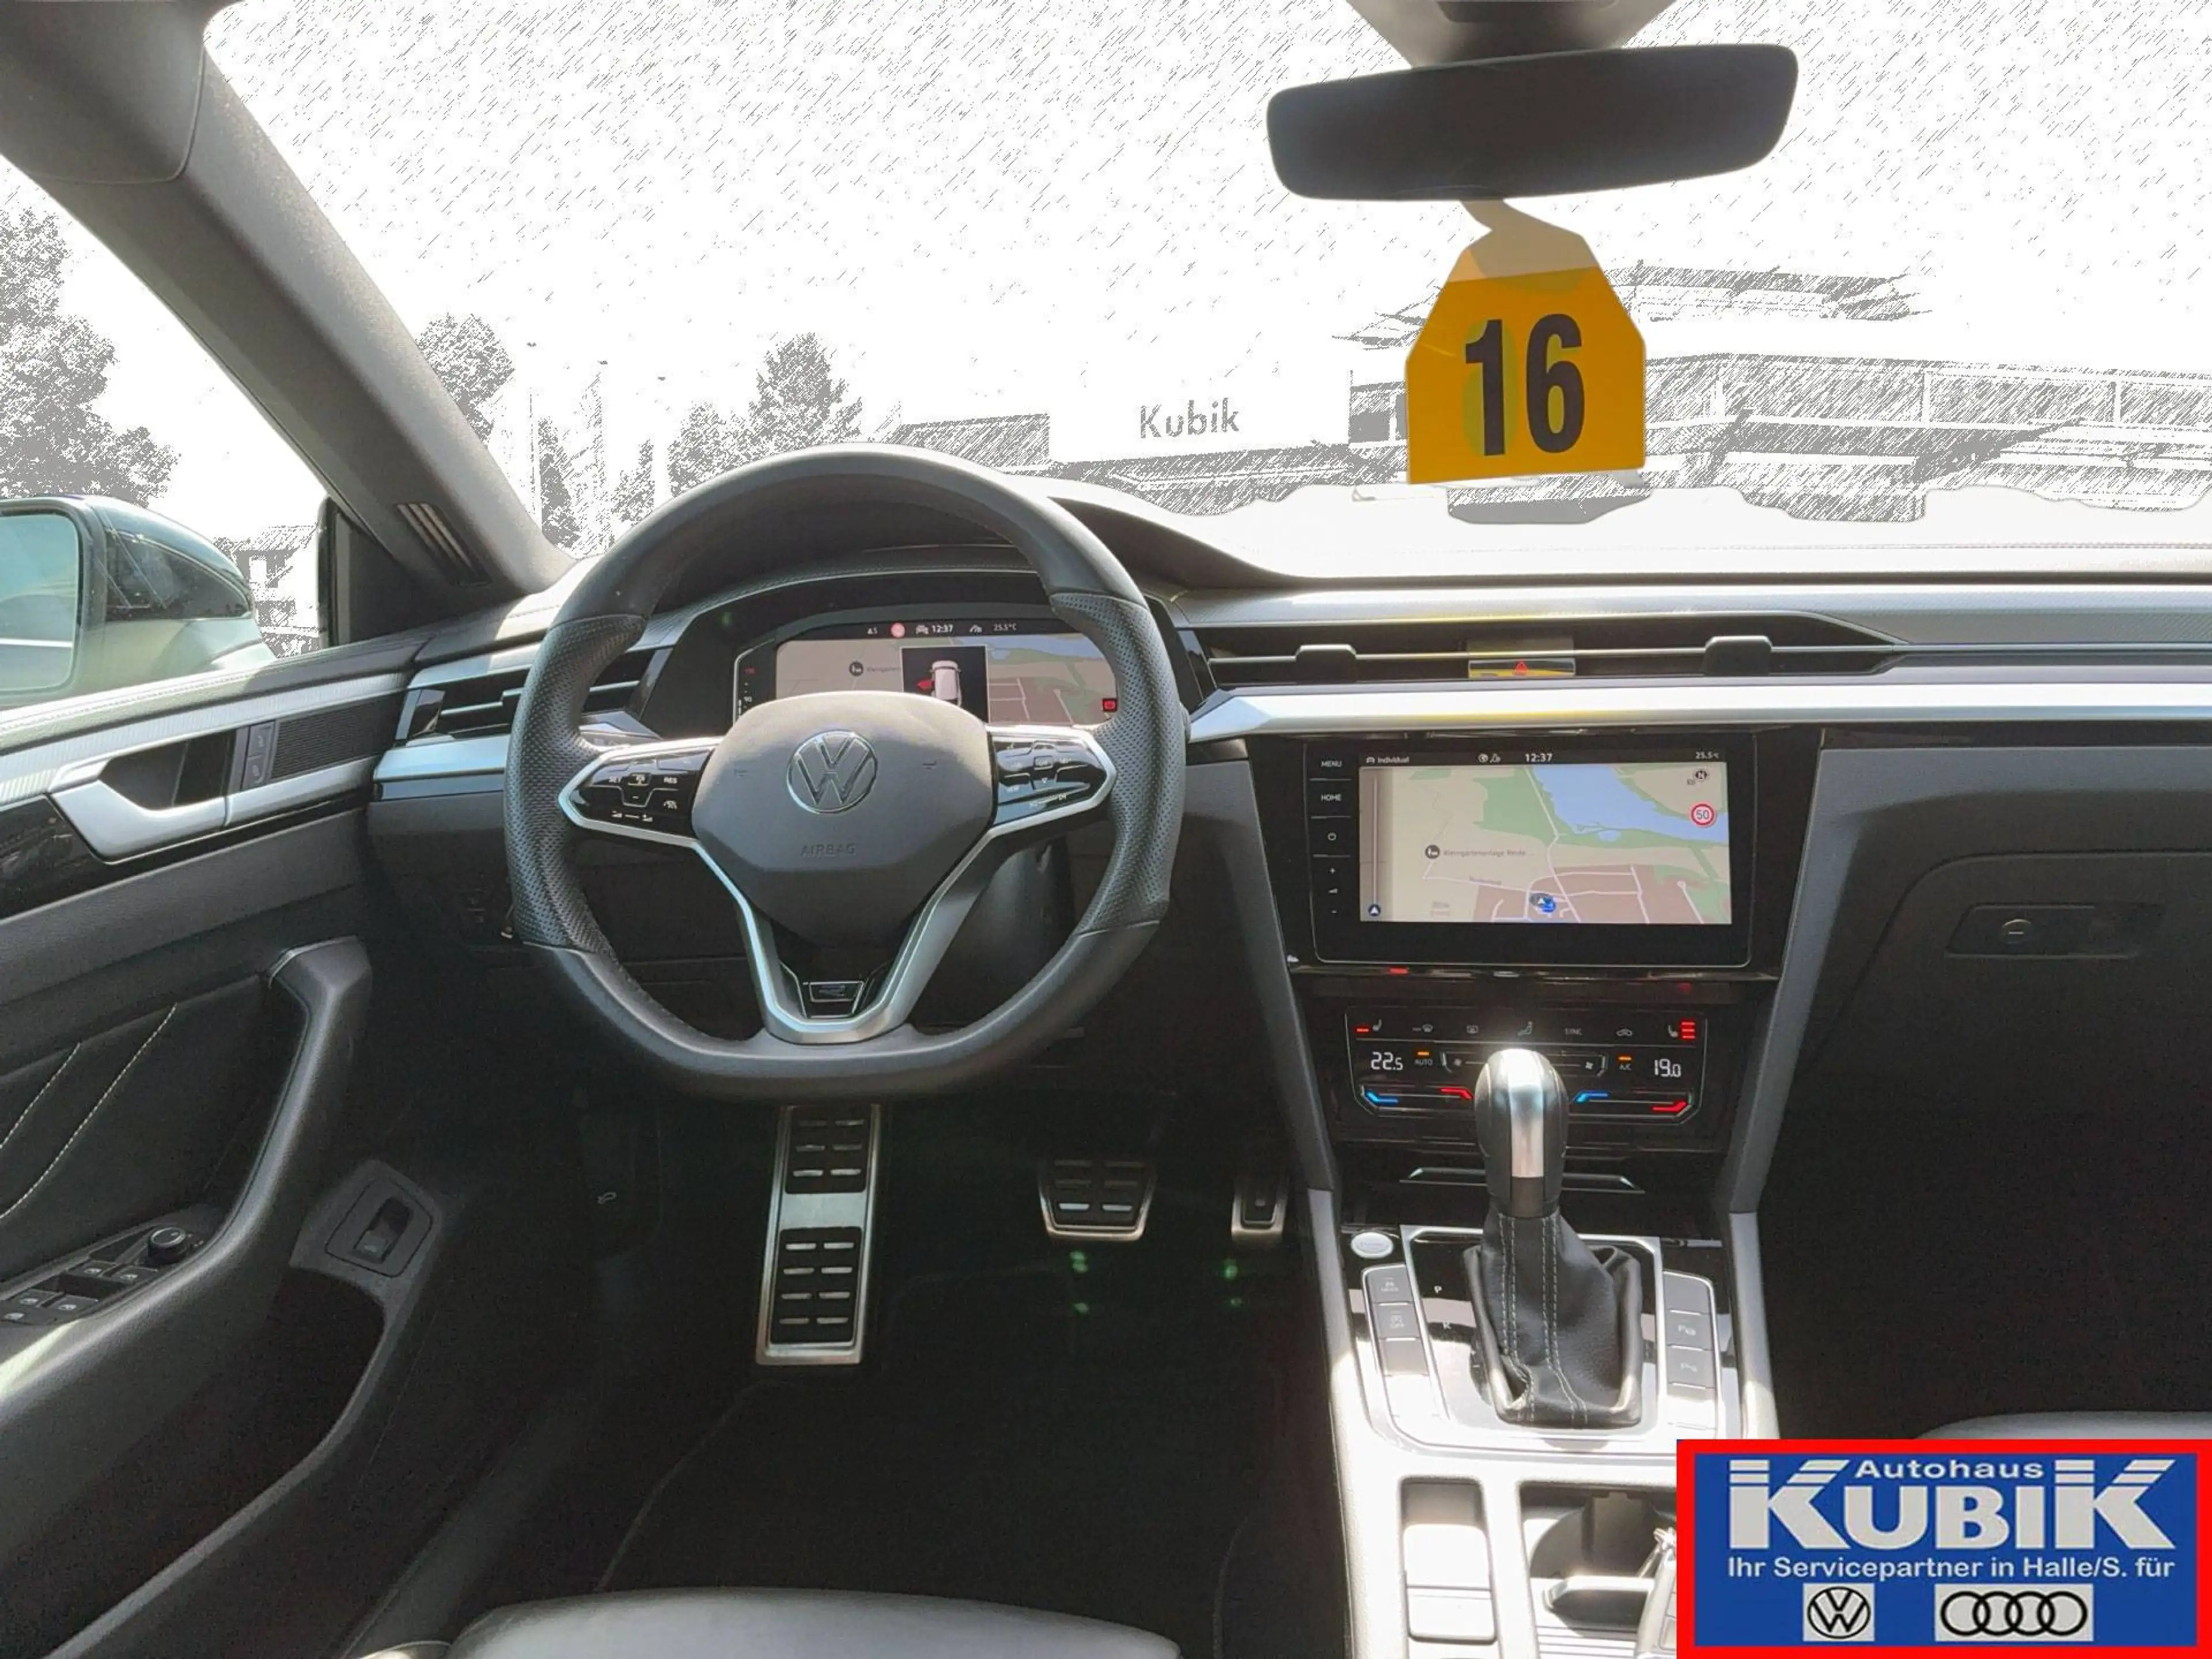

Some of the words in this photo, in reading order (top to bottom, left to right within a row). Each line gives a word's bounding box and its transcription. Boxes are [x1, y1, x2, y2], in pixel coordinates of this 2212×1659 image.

[1465, 313, 1585, 456] 16
[1140, 398, 1240, 439] Kubik
[931, 624, 954, 633] 12:37
[1525, 753, 1553, 763] 12:37
[1321, 760, 1342, 768] MENU
[1321, 793, 1342, 801] HOME
[1696, 809, 1710, 820] 50
[800, 843, 857, 857] AIRBAG
[1371, 1051, 1403, 1070] 22.5
